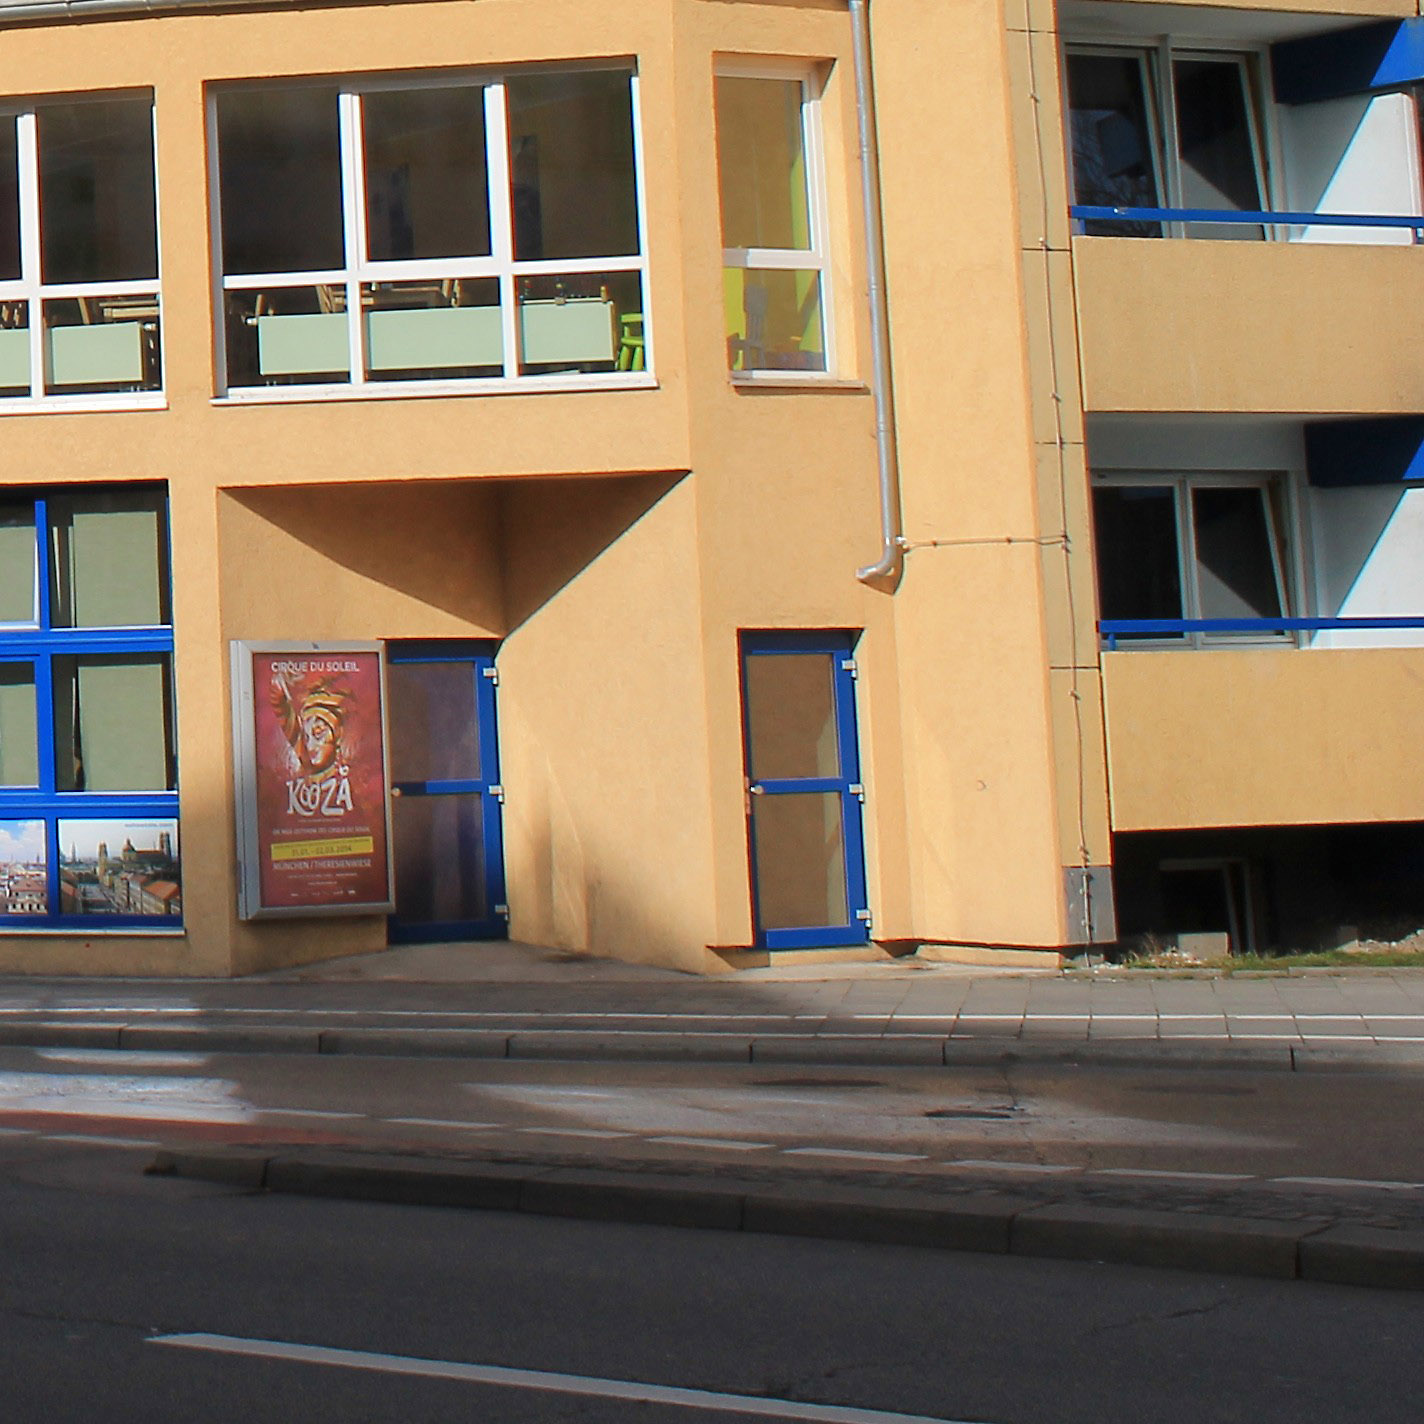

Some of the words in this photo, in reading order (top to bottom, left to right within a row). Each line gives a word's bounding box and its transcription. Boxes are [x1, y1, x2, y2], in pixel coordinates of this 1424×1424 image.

[271, 661, 308, 673] CIRQUE
[310, 661, 325, 672] DU
[326, 661, 360, 672] SOLEIL
